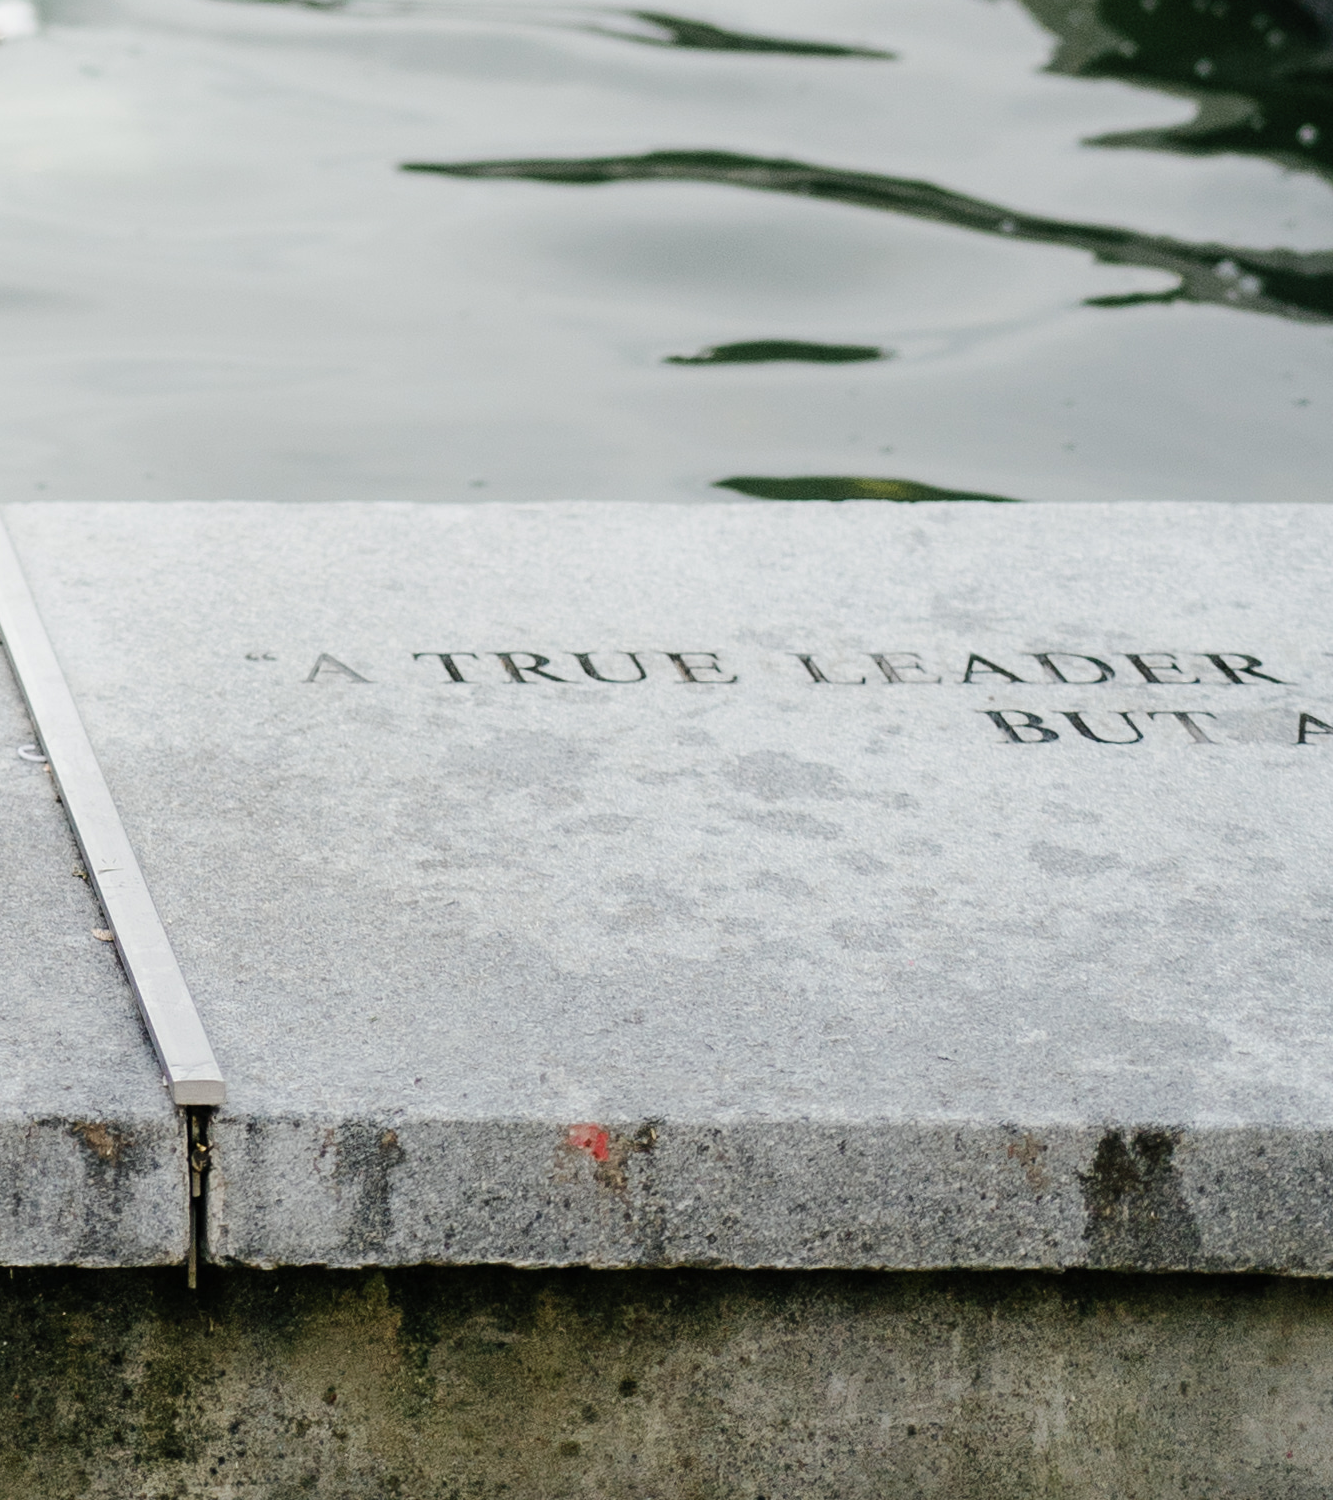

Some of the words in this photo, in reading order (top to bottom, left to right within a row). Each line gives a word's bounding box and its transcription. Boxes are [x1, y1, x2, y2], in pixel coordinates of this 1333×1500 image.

[413, 651, 739, 685] TRUE
[785, 651, 1298, 686] LEADER
[974, 709, 1222, 745] BUT
